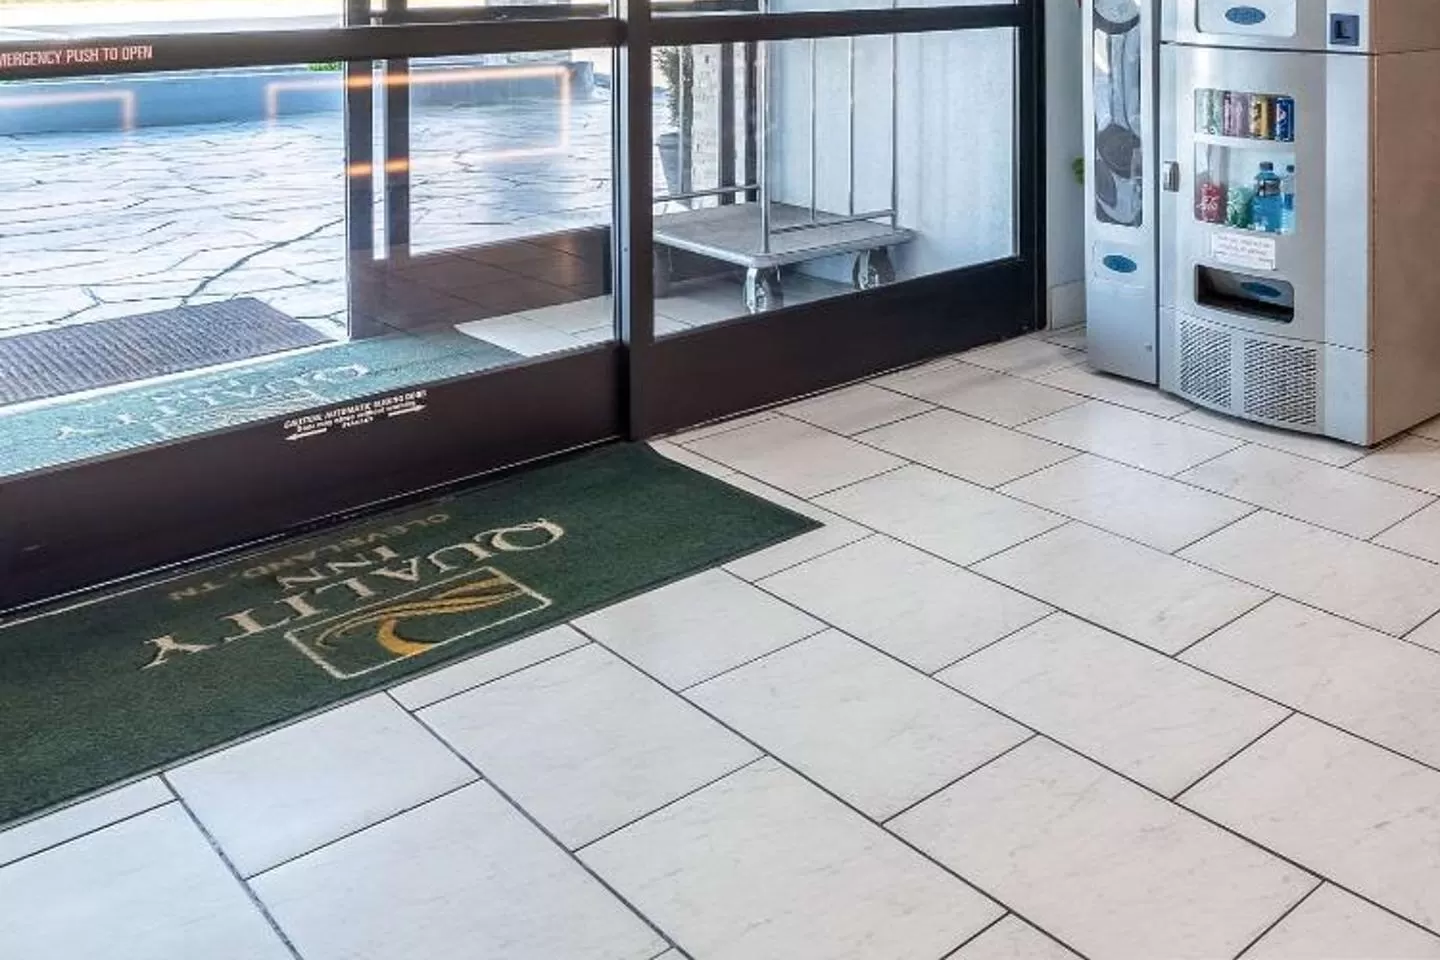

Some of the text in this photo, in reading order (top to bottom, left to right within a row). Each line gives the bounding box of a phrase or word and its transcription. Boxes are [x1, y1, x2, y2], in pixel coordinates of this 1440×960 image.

[66, 47, 99, 64] PUSH
[101, 47, 118, 61] TO
[122, 45, 153, 60] OPEN
[275, 543, 401, 592] INN
[138, 517, 565, 670] QUALITY
